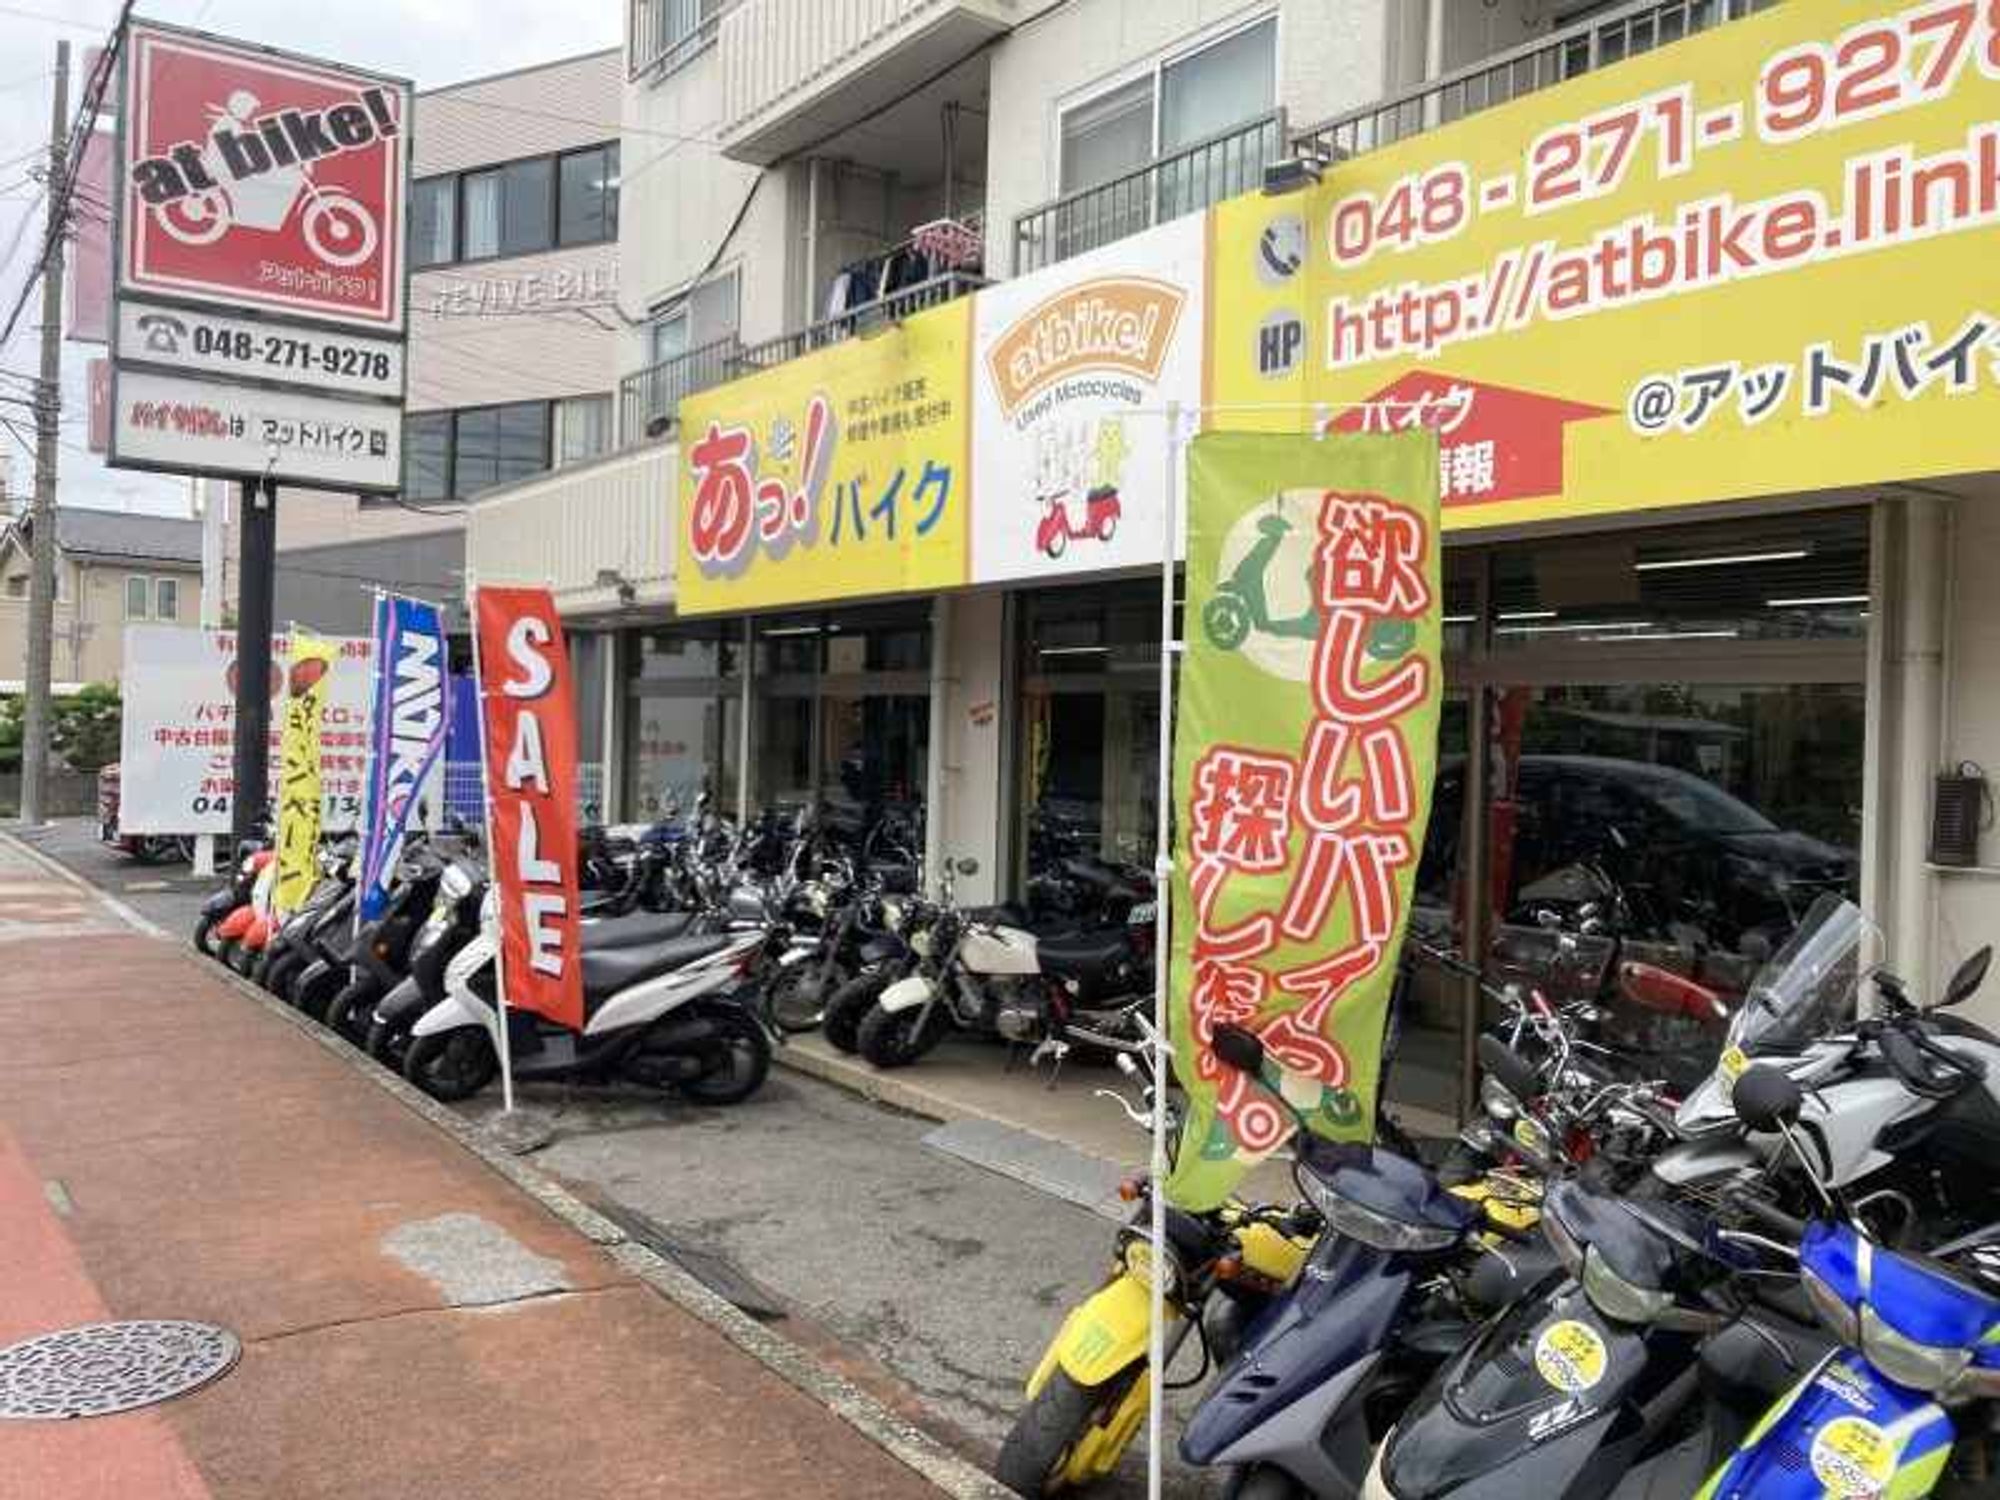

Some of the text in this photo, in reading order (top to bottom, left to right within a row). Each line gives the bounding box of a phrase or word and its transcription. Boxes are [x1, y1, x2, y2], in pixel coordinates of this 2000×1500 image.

[133, 90, 398, 203] at bike!
[193, 326, 390, 381] 048-271-9278
[1260, 320, 1301, 373] HP
[1634, 321, 2000, 429] @アットバイ
[830, 460, 951, 546] バイク
[503, 615, 567, 979] SALE
